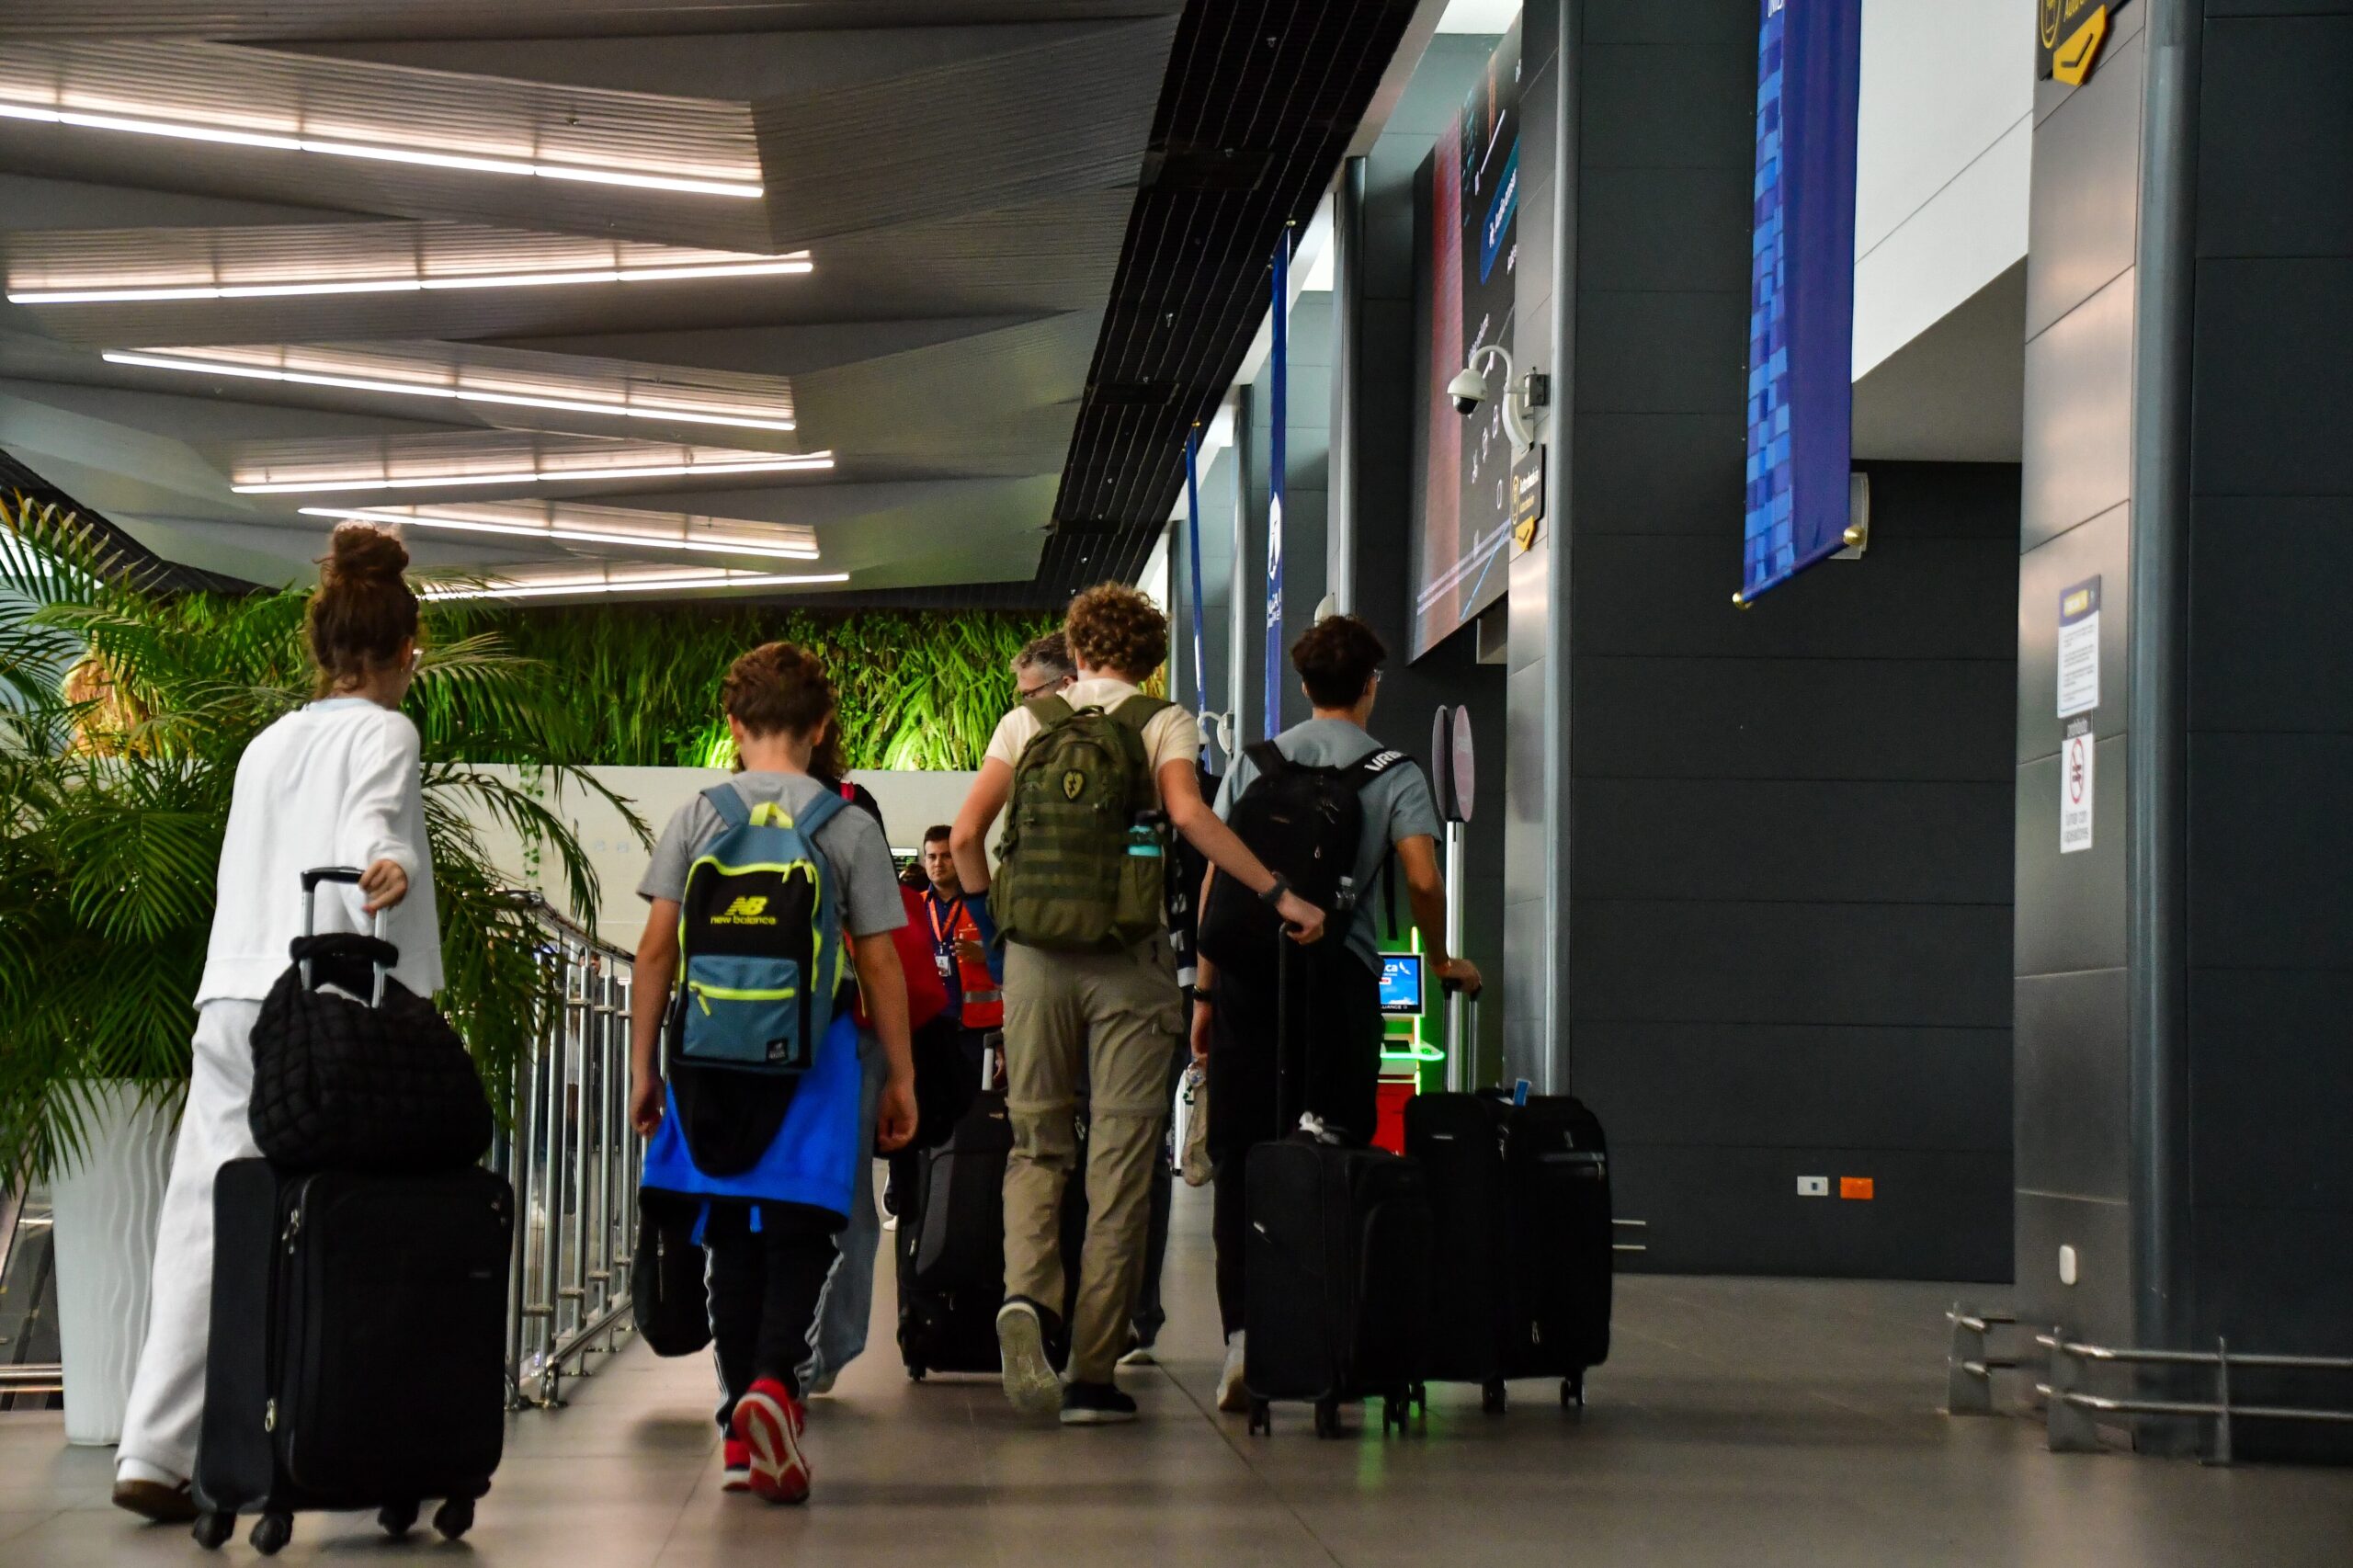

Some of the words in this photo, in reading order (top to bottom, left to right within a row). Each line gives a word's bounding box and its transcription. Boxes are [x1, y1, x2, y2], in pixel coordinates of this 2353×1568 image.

[724, 896, 768, 915] NB
[710, 916, 732, 925] new
[733, 915, 776, 925] balance
